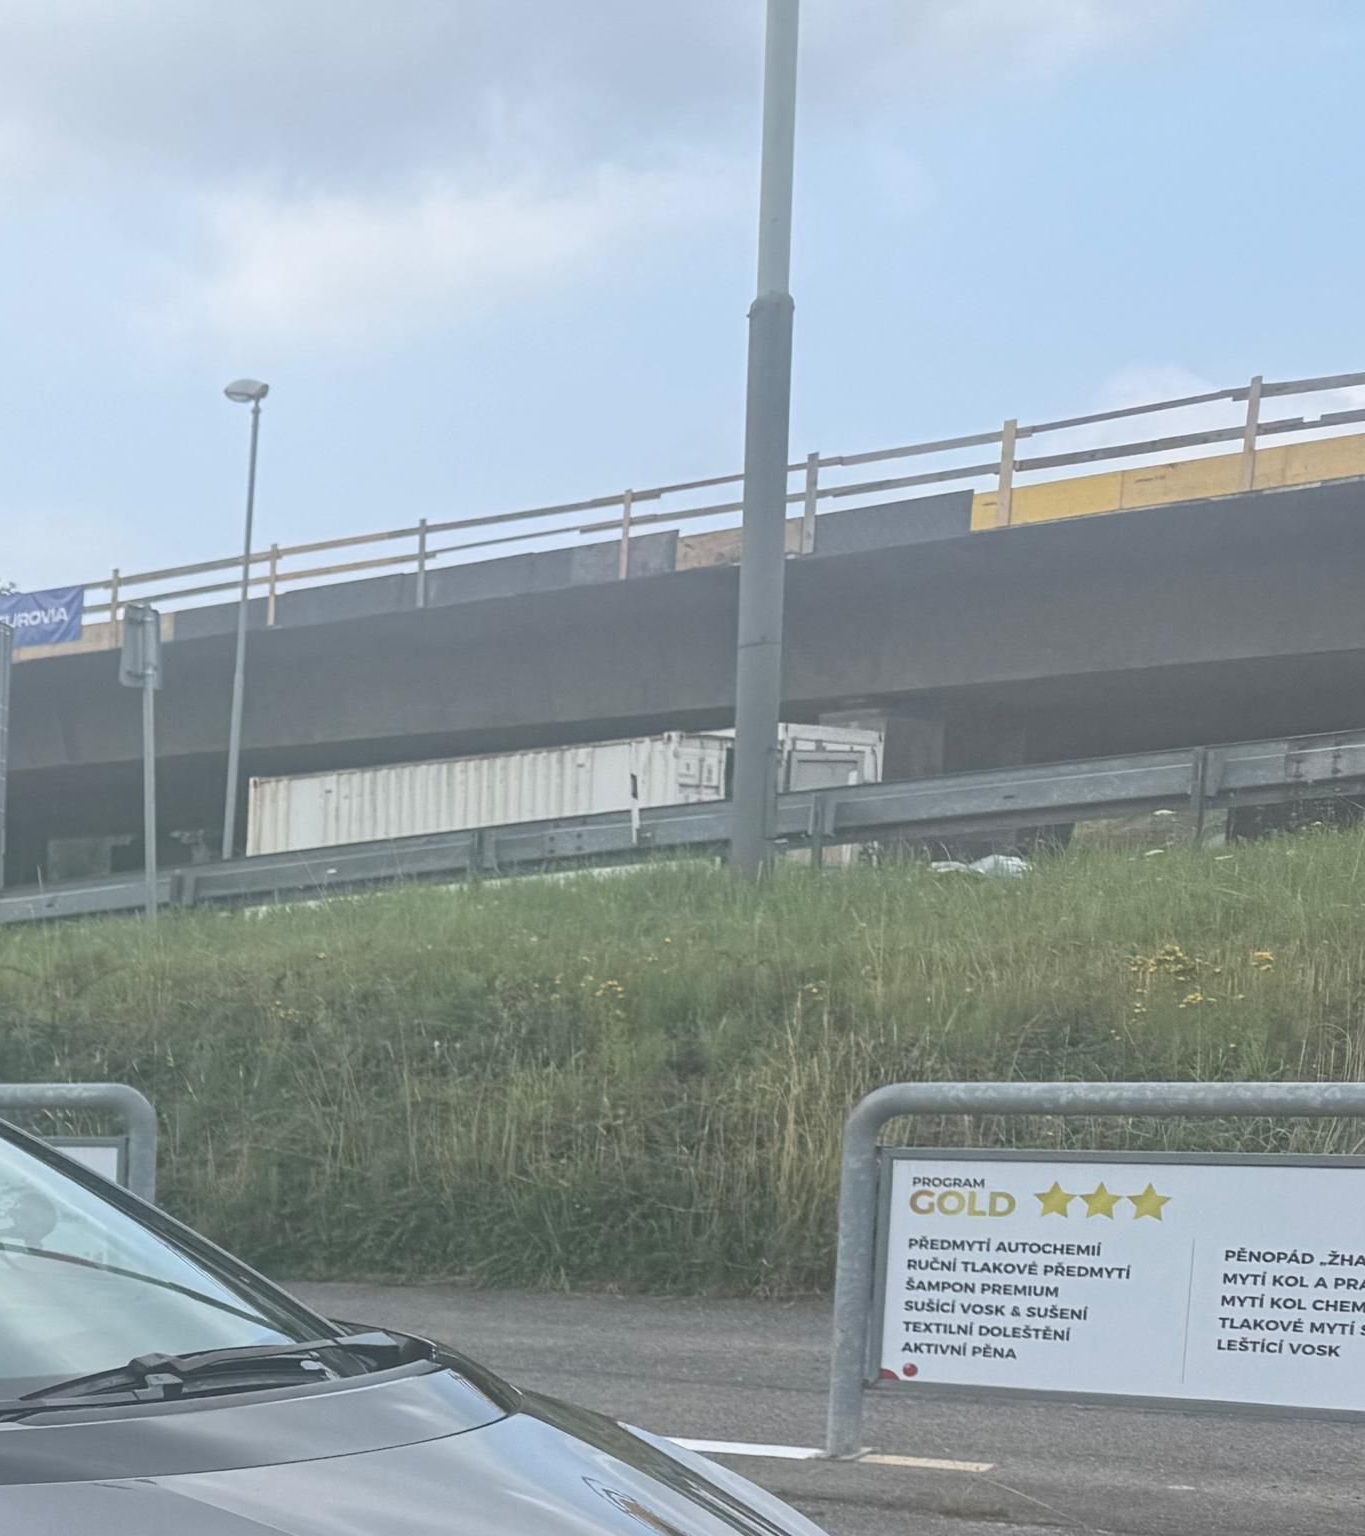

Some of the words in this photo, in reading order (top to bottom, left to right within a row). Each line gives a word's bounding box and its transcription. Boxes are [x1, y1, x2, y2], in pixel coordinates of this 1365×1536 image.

[912, 1176, 986, 1189] PROGRAM
[909, 1189, 1017, 1217] GOLD
[908, 1235, 991, 1253] PŘEDMYTÍ
[995, 1239, 1102, 1257] AUTOCHEMIÍ
[1224, 1247, 1315, 1265] PĚNOPÁD
[906, 1256, 957, 1273] RUČNÍ
[961, 1260, 1039, 1276] TLAKOVÉ
[1043, 1262, 1131, 1280] PŘEDMYTÍ
[905, 1276, 976, 1294] ŠAMPON
[980, 1282, 1060, 1298] PREMIUM
[1222, 1271, 1267, 1287] MYTÍ
[1271, 1274, 1310, 1288] KOL
[1314, 1277, 1328, 1289] A
[903, 1298, 956, 1314] SUŠÍCÍ
[960, 1302, 1006, 1317] VOSK
[1010, 1304, 1022, 1317] &
[1025, 1304, 1089, 1321] SUŠENÍ
[1220, 1293, 1265, 1308] MYTÍ
[1270, 1297, 1307, 1310] KOL
[1311, 1299, 1365, 1314] CHEM
[902, 1320, 974, 1336] TEXTILNÍ
[978, 1324, 1071, 1342] DOLEŠTĚNÍ
[1218, 1317, 1305, 1333] TLAKOVÉ
[1309, 1320, 1356, 1336] MYTÍ
[901, 1340, 968, 1357] AKTIVNÍ
[971, 1342, 1017, 1360] PĚNA
[1216, 1337, 1285, 1354] LEŠTÍCÍ
[1289, 1342, 1341, 1358] VOSK
